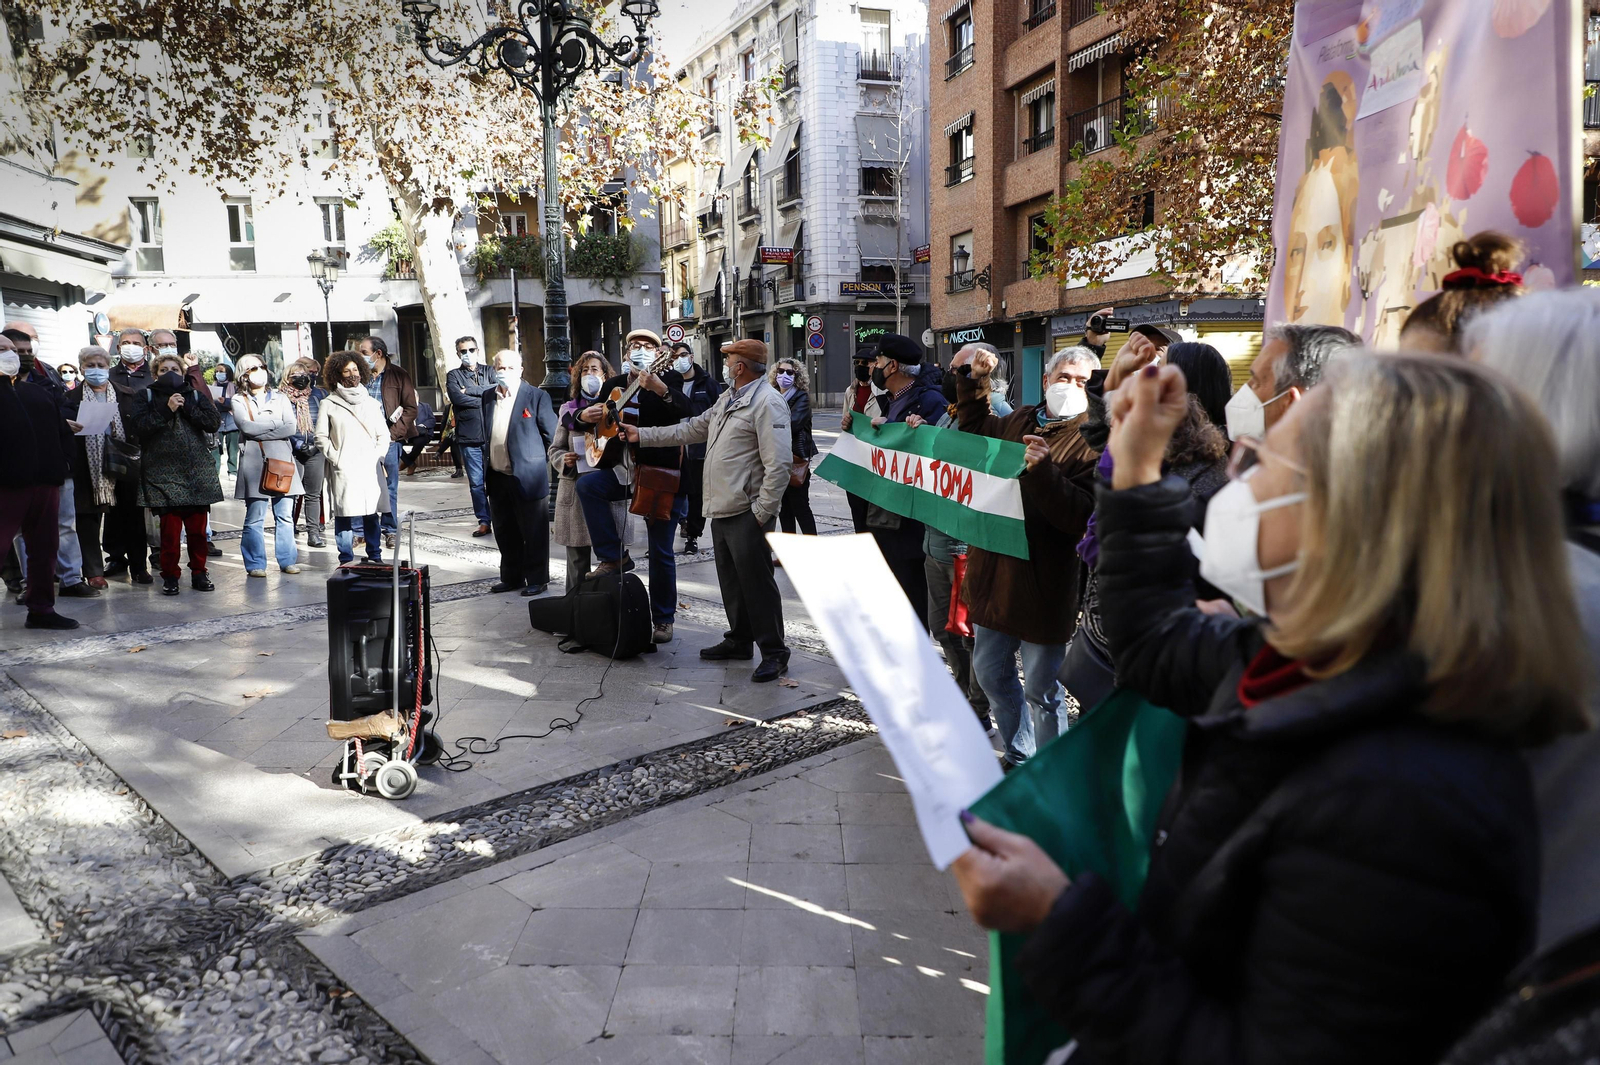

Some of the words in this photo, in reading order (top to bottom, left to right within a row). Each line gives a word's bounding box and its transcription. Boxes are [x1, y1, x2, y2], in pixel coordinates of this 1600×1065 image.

[871, 447, 887, 477] NO
[891, 451, 899, 483] A
[903, 454, 924, 489] LA
[929, 459, 973, 507] TOMA
